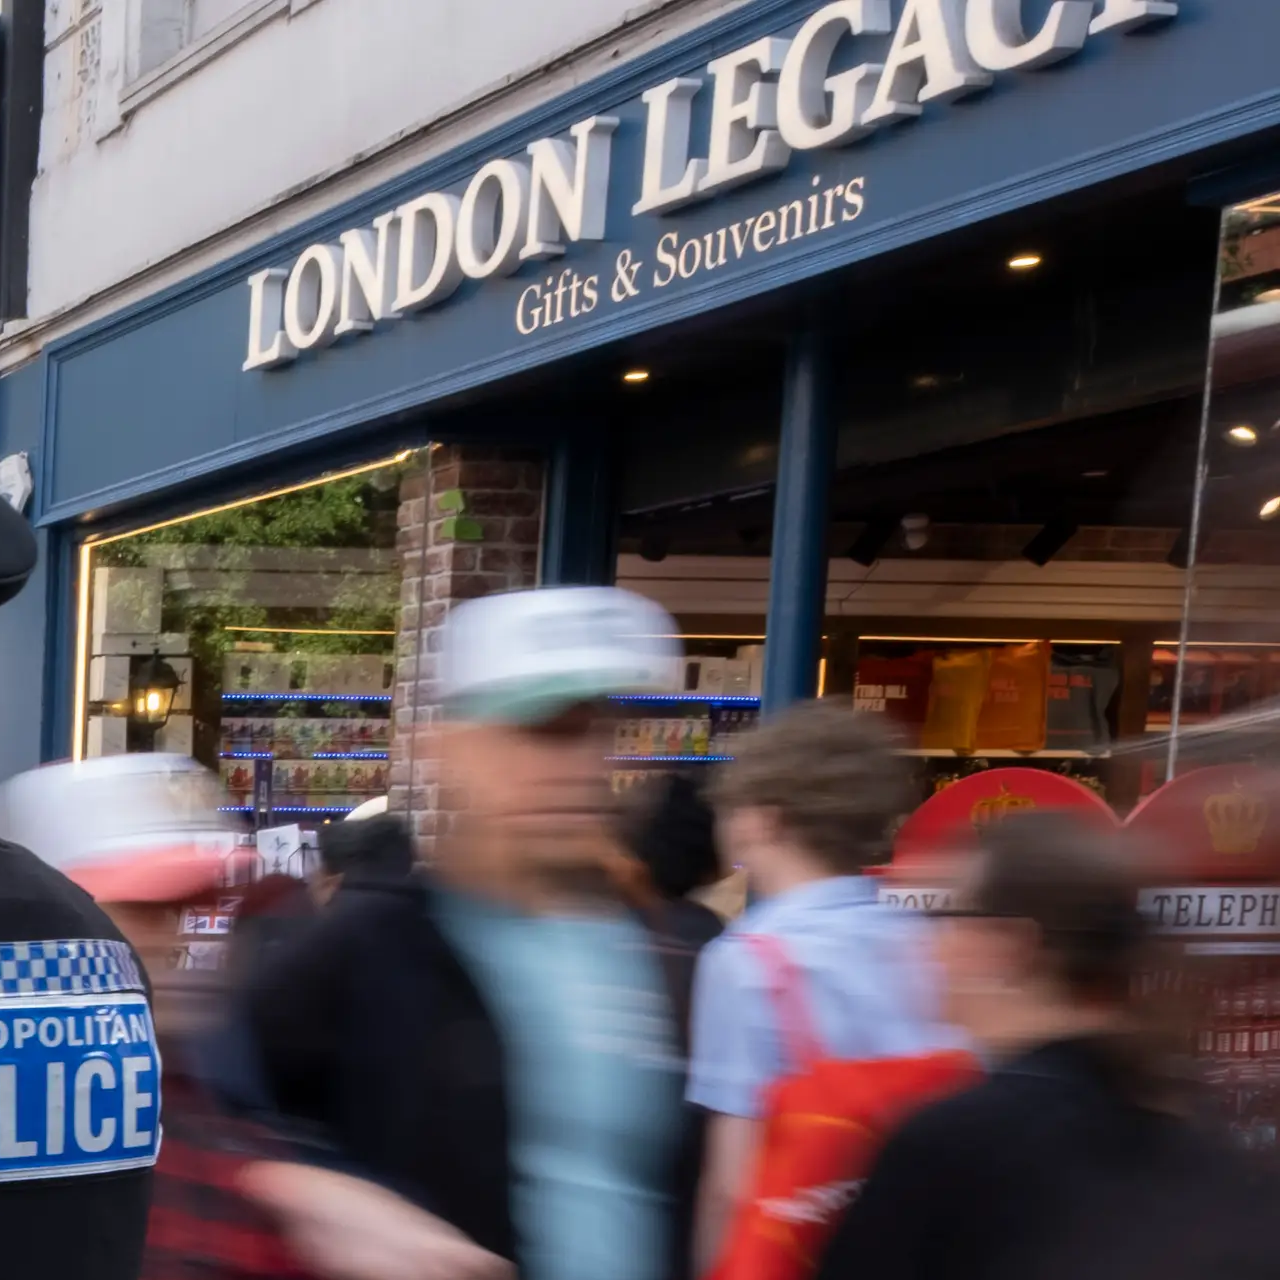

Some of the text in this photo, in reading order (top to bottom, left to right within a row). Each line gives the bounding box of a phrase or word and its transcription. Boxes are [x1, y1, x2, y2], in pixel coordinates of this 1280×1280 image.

[242, 0, 1178, 371] LONDON LEGAC
[515, 175, 865, 335] Gifts & Souvenirs
